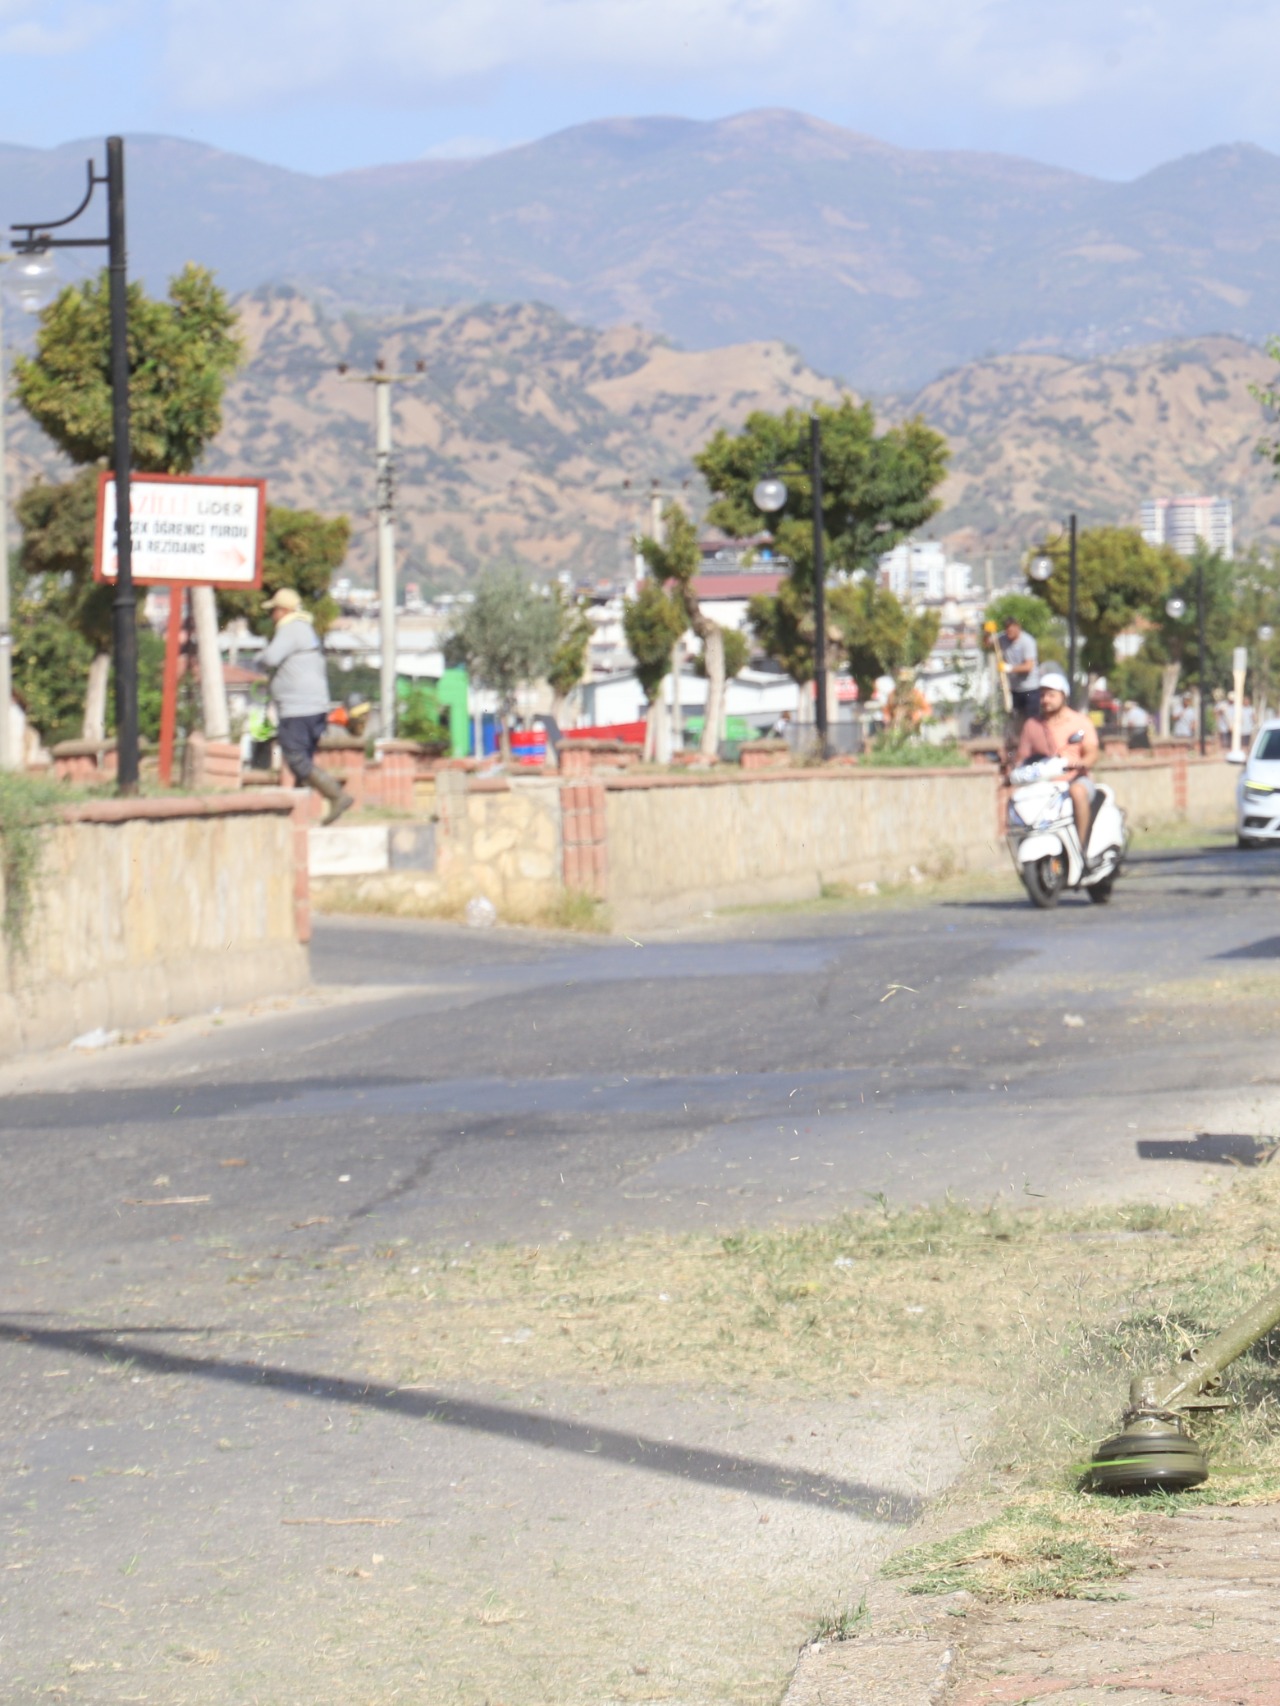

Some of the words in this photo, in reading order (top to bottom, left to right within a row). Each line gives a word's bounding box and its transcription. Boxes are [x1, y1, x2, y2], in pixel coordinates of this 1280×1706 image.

[197, 500, 243, 516] LİDER
[153, 519, 205, 537] ÖĞRENCİ
[148, 538, 206, 555] REZİDANS
